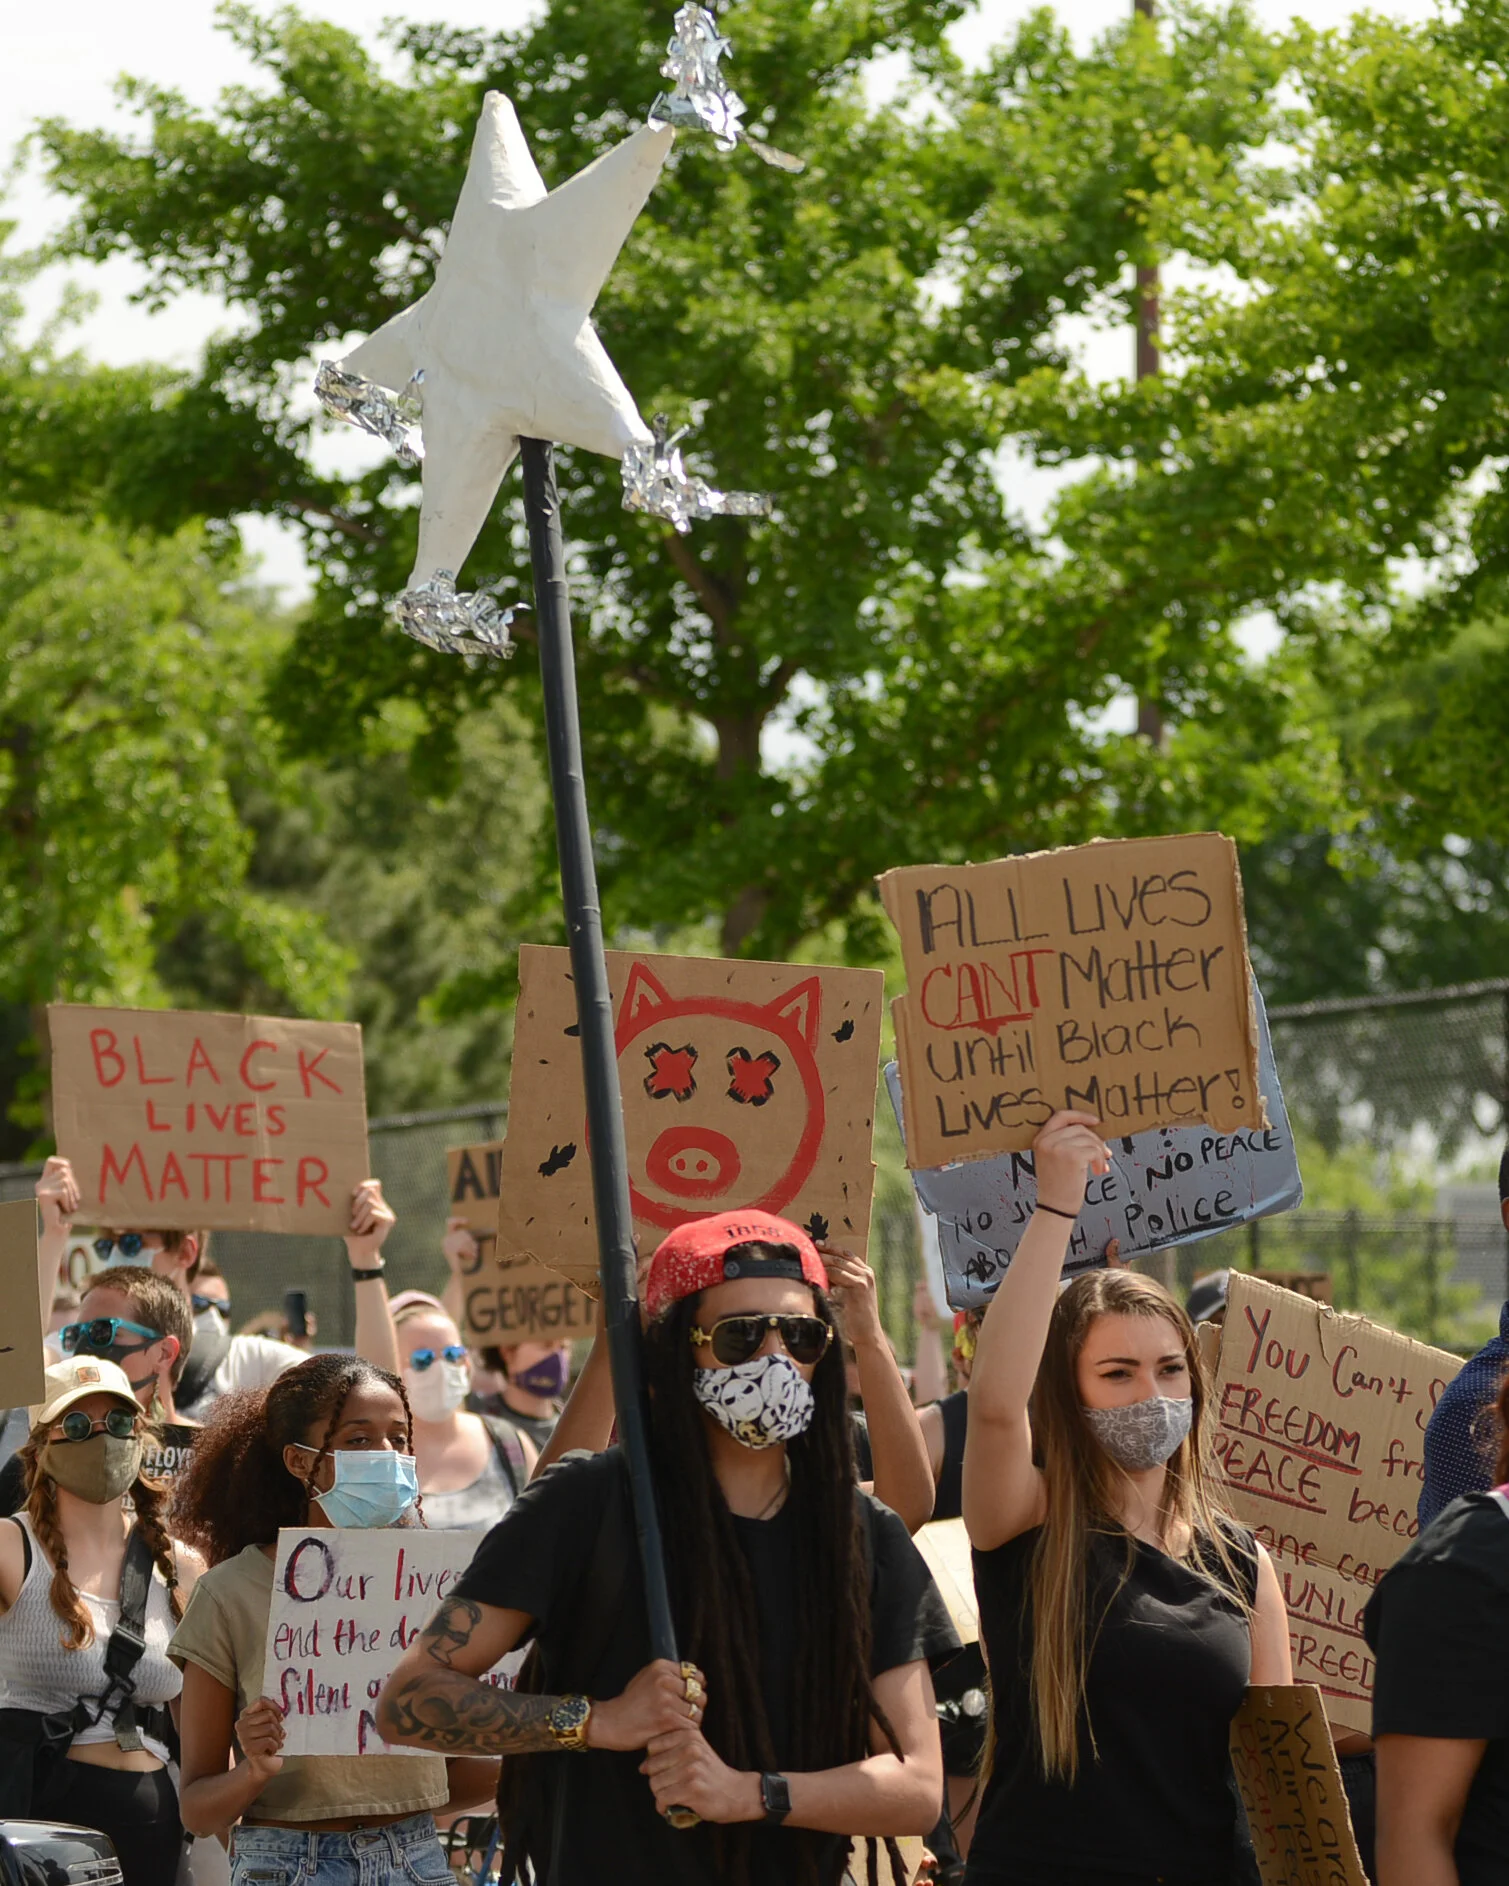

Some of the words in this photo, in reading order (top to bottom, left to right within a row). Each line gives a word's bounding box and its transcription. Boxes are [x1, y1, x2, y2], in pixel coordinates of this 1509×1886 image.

[916, 883, 1050, 955] ALL
[920, 949, 1056, 1030] CANT
[1059, 939, 1225, 1010] Matter
[89, 1028, 343, 1098] BLACK
[1055, 1006, 1202, 1064] Black
[145, 1096, 286, 1136] LIVES
[936, 1087, 1054, 1137] Lives
[1064, 1068, 1246, 1124] Matter!
[98, 1142, 331, 1208] MATTER
[954, 1207, 993, 1243] NO
[1146, 1152, 1194, 1192] NO
[1200, 1126, 1283, 1164] PEACE
[962, 1224, 1087, 1290] ABOH
[1243, 1305, 1310, 1379] You
[1333, 1345, 1414, 1403] Can't
[1219, 1383, 1360, 1464] FREEDOM
[1210, 1432, 1321, 1503] PEACE
[283, 1537, 374, 1601] Our
[273, 1619, 321, 1660] end
[333, 1618, 380, 1656] the
[272, 1667, 352, 1718] Silent
